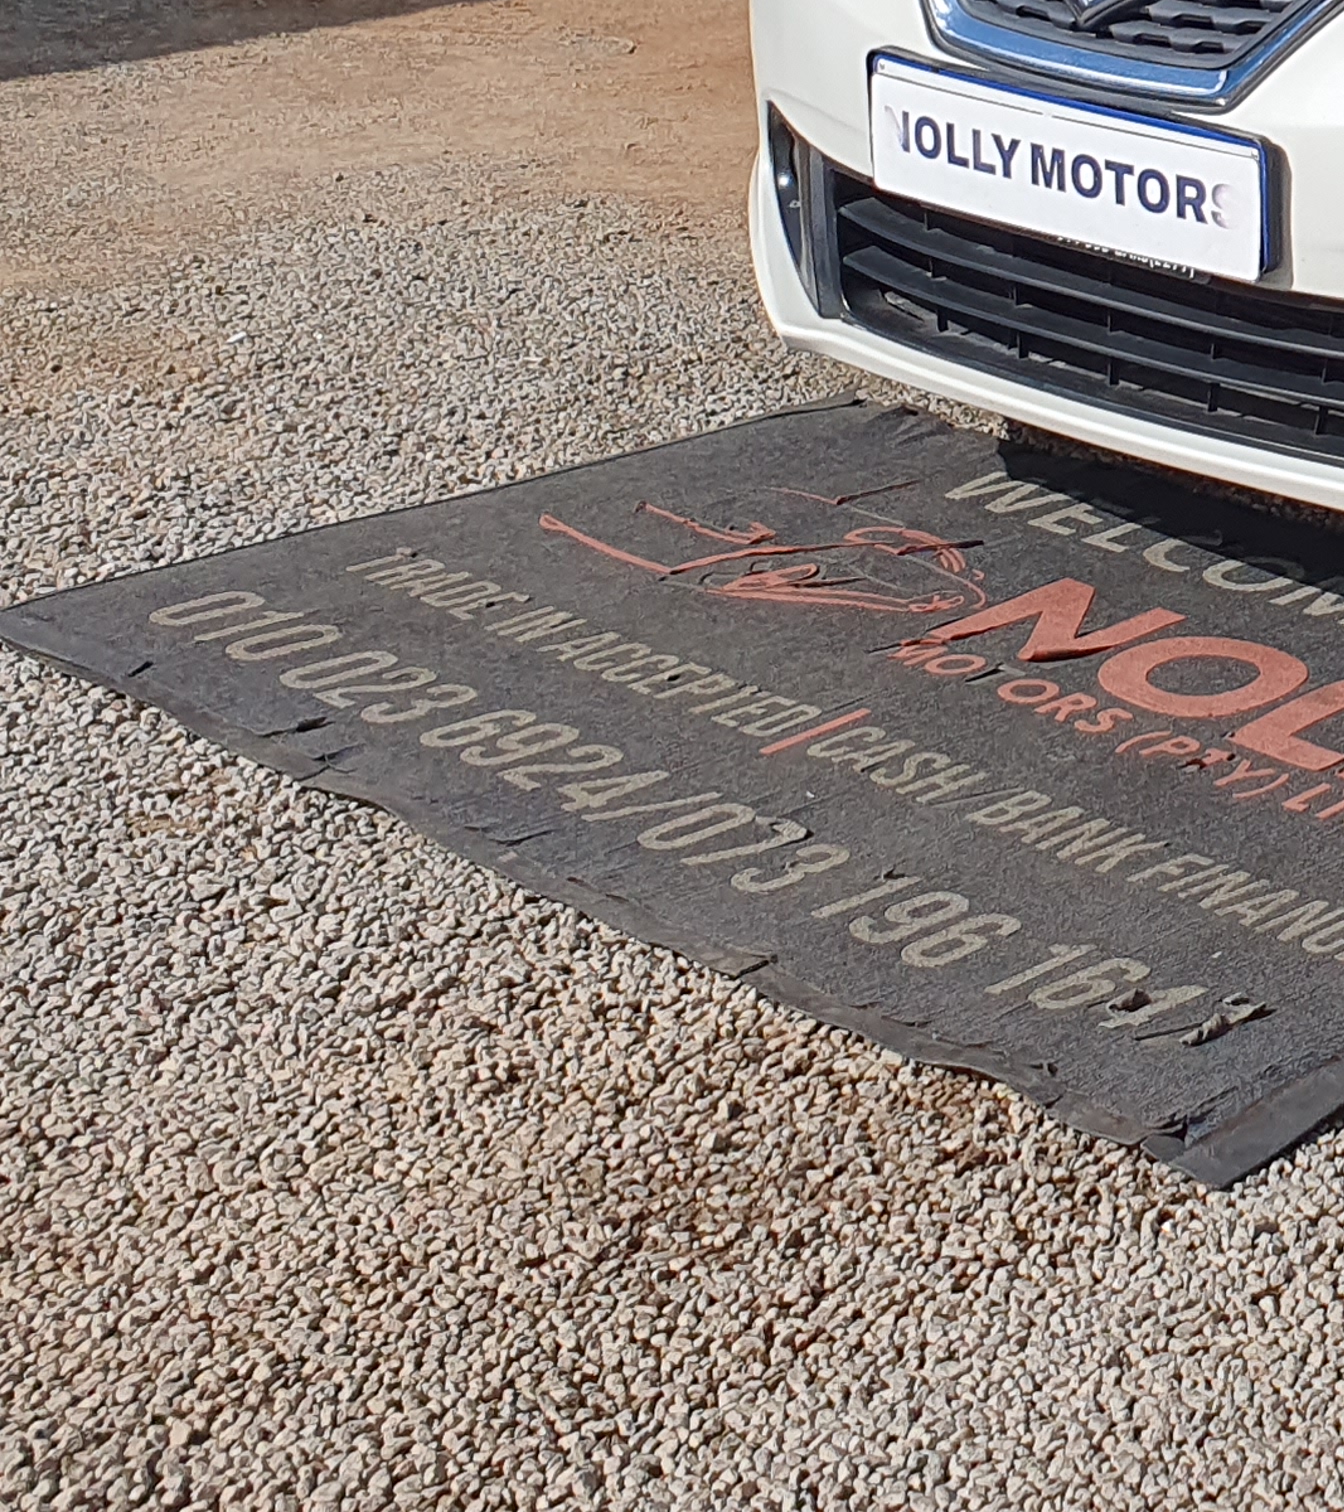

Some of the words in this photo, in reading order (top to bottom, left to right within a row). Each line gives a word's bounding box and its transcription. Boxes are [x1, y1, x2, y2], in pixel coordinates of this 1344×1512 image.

[150, 590, 346, 662] 010
[279, 649, 478, 724] 023
[810, 870, 1022, 969] 196
[345, 547, 531, 620] TRADE
[484, 605, 587, 643] IN
[538, 631, 822, 738] ACCEPTED
